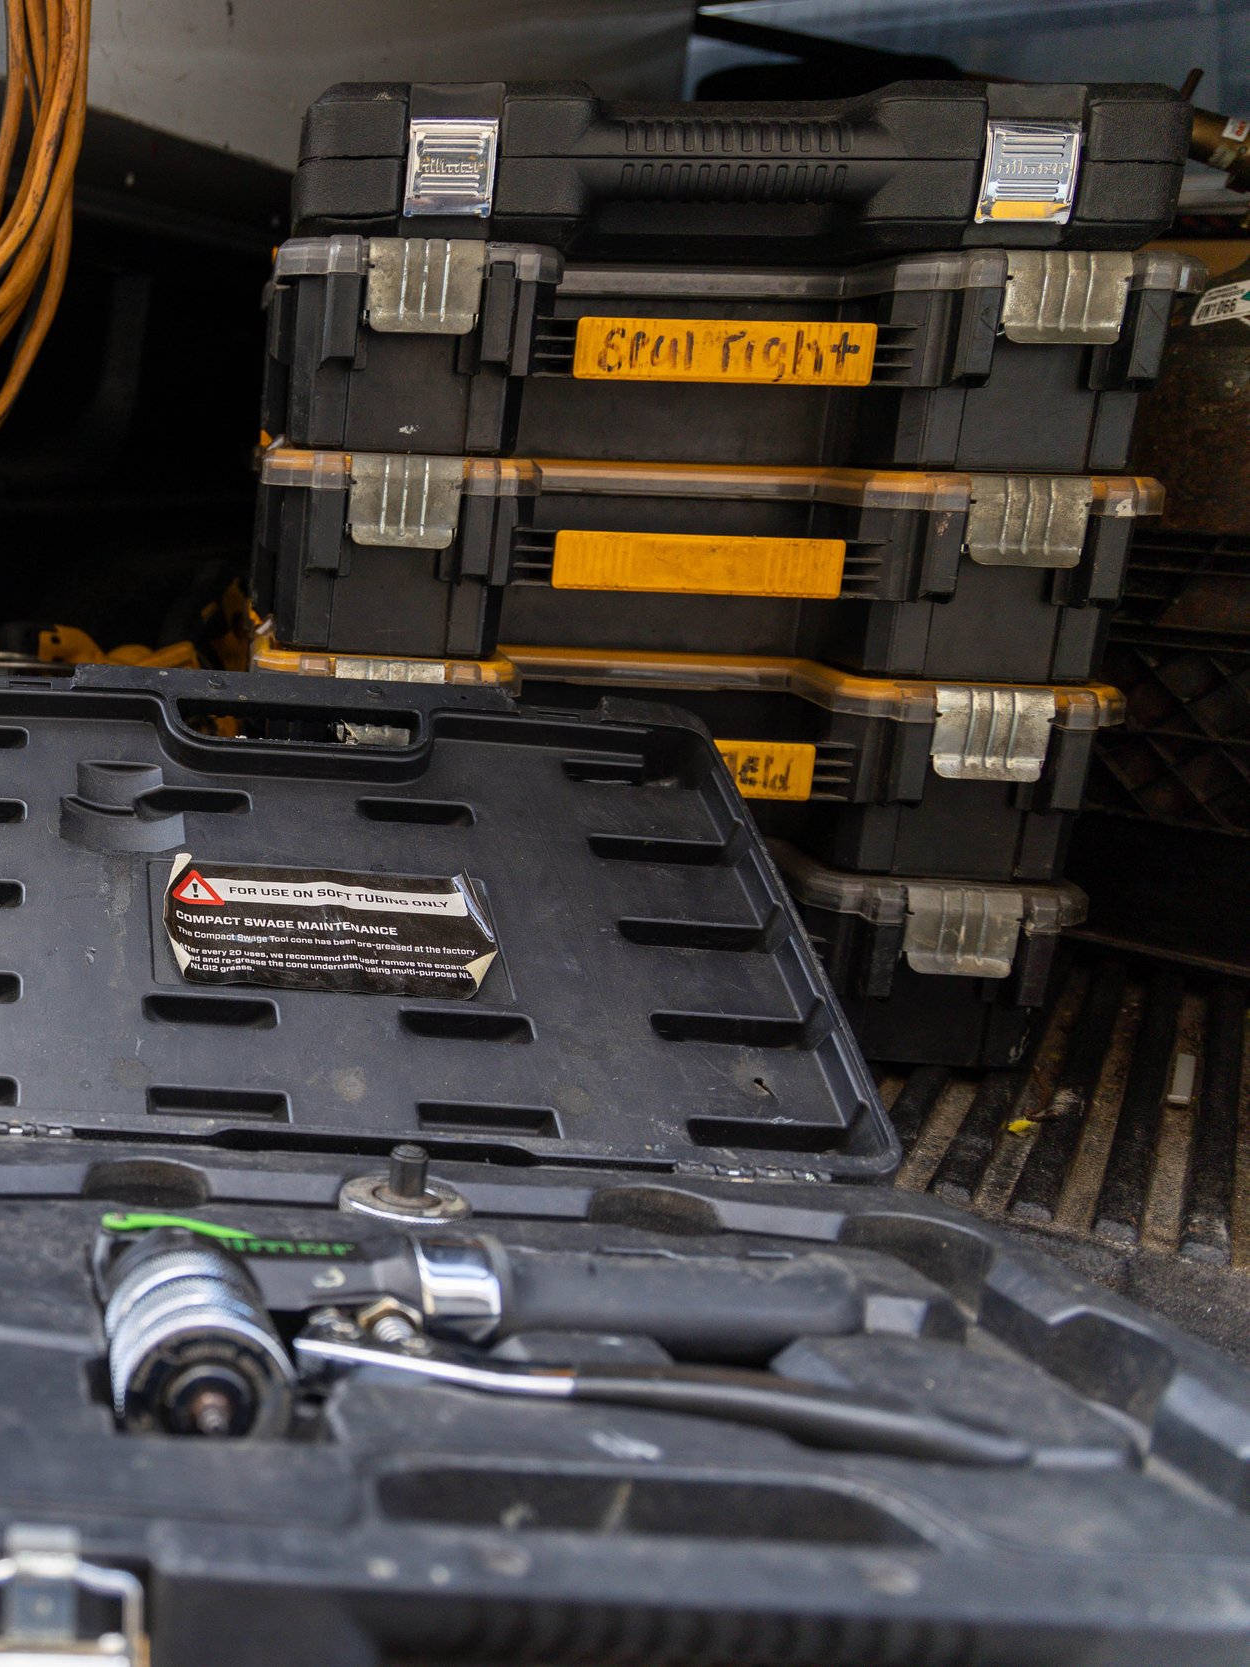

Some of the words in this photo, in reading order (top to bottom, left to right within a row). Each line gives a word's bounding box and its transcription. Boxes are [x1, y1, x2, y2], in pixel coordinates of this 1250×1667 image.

[229, 886, 257, 896] FOR
[261, 888, 289, 898] USE
[293, 889, 313, 899] ON
[317, 888, 353, 901] SOFT
[355, 893, 410, 906] TUBING
[412, 900, 449, 908] ONLY
[175, 909, 241, 926] COMPACT
[244, 917, 295, 929] SWAGE
[297, 920, 398, 936] MAINTENANCE
[177, 925, 193, 937] The
[194, 931, 236, 942] Compact
[237, 933, 268, 944] Swage
[269, 935, 289, 943] Tool
[290, 937, 313, 945] cone
[315, 937, 332, 946] has
[333, 938, 356, 946] been
[357, 941, 412, 953] pre-greased
[414, 945, 424, 953] at
[425, 946, 441, 954] the
[442, 946, 478, 957] factory.
[201, 947, 227, 957] every
[243, 950, 269, 960] uses,
[270, 952, 283, 960] we
[285, 951, 340, 962] recommend
[342, 953, 358, 961] the
[359, 957, 379, 965] user
[381, 959, 415, 968] remove
[417, 961, 432, 969] the
[202, 956, 219, 964] and
[221, 958, 267, 969] re-grease
[268, 959, 284, 968] the
[285, 961, 309, 970] cone
[310, 962, 364, 971] underneath
[365, 965, 391, 976] using
[392, 968, 458, 980] multi-purpose
[220, 964, 255, 974] grease.
